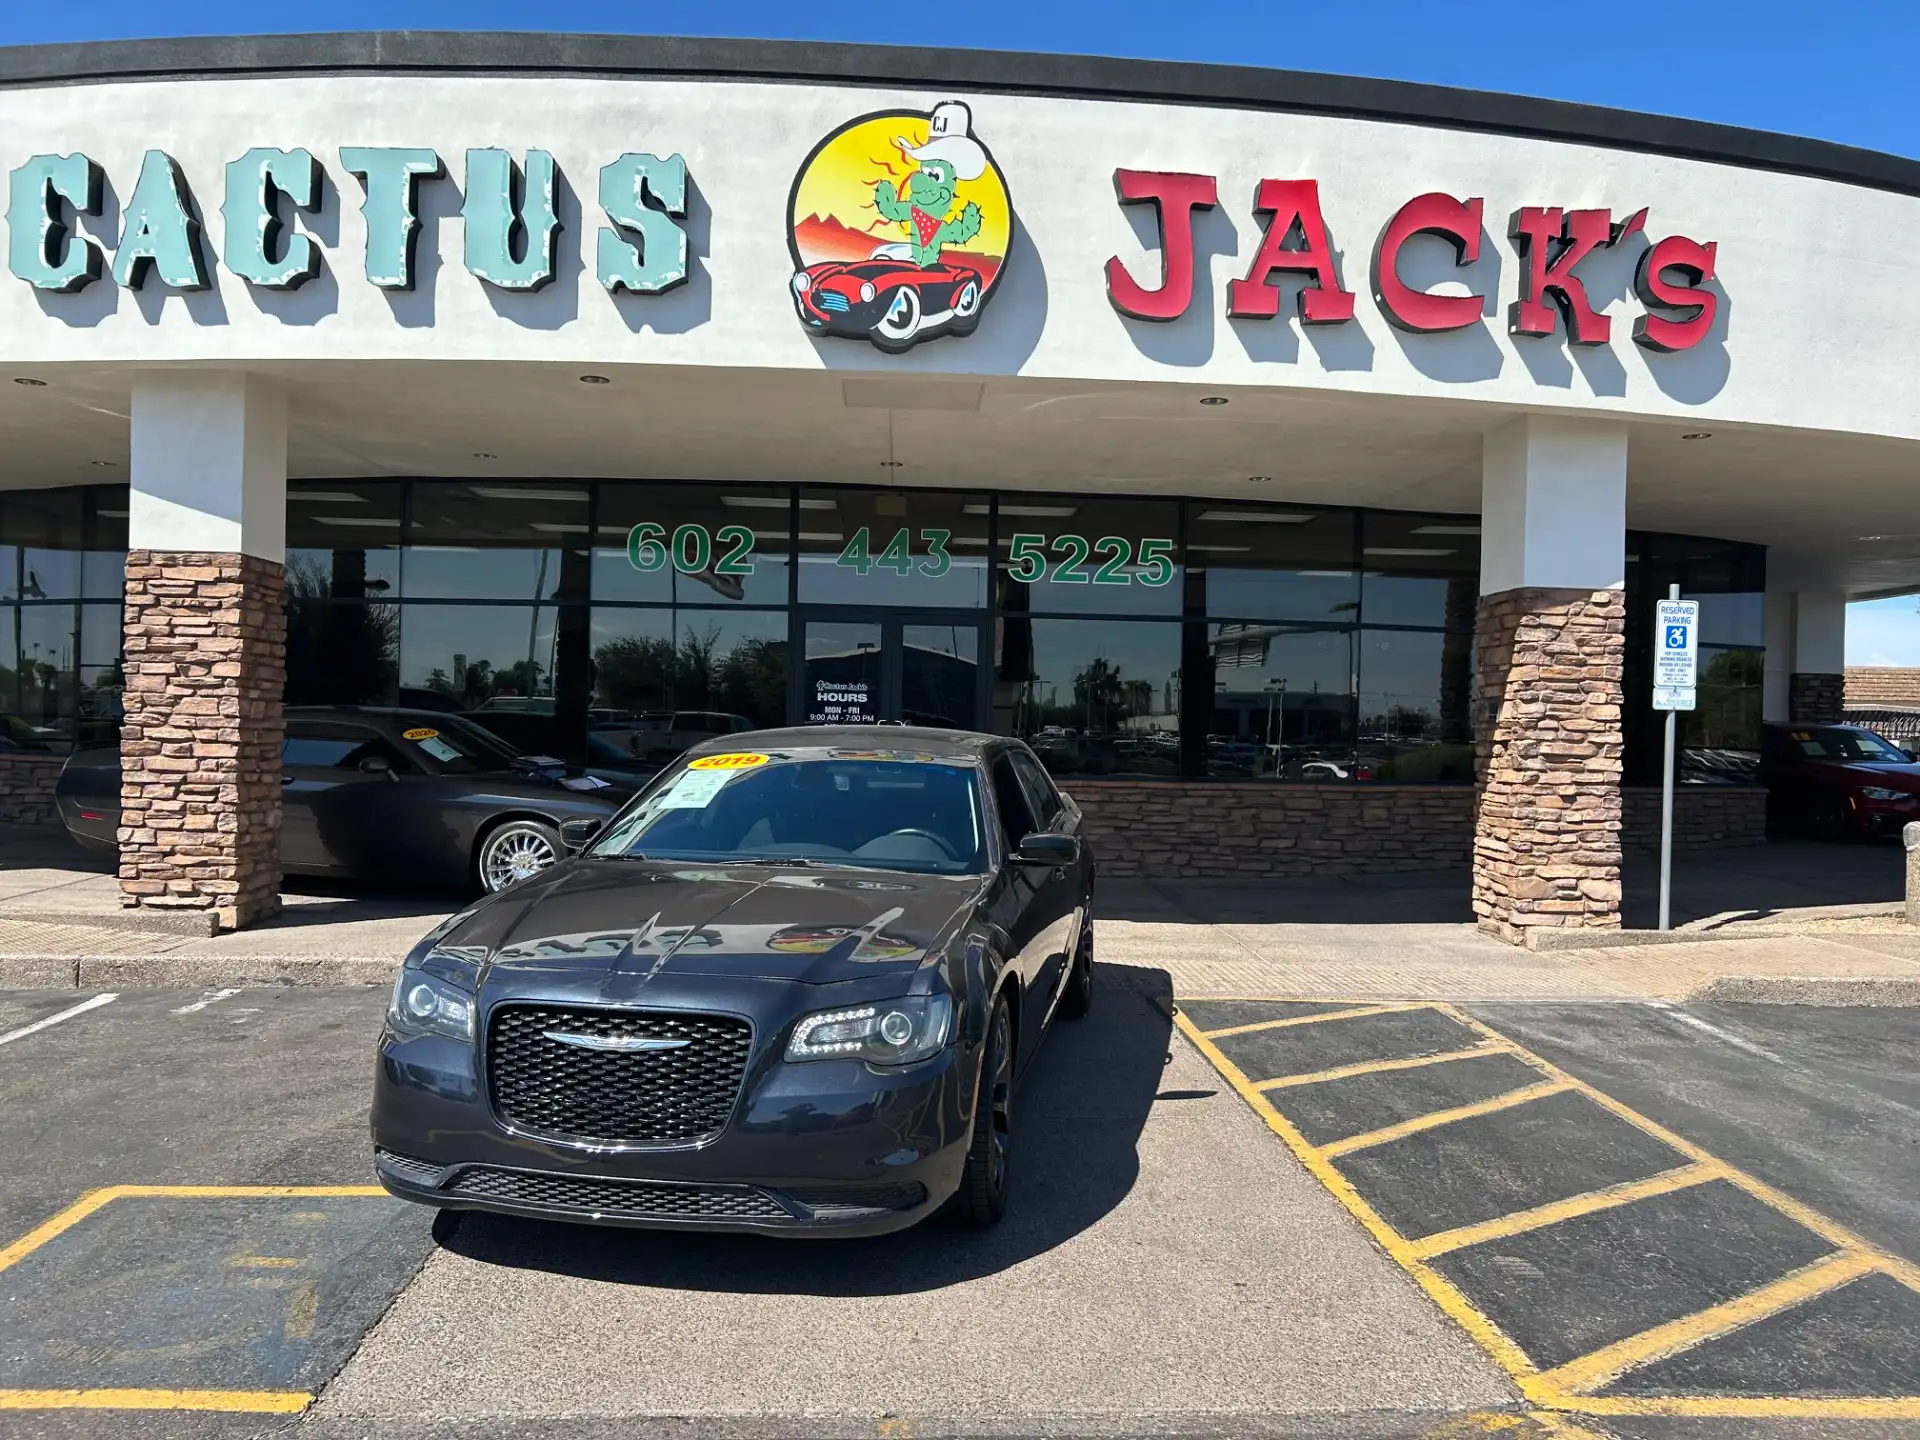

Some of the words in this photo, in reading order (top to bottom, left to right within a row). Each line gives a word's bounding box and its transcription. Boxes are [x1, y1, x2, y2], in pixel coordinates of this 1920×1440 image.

[931, 115, 949, 133] CJ
[4, 146, 690, 295] CACTUS
[626, 521, 756, 576] 602
[835, 526, 952, 577] 443
[1007, 533, 1174, 588] 5225
[1661, 606, 1695, 615] RESERVED
[1663, 616, 1692, 625] PARKING
[817, 692, 868, 703] HOURS
[824, 706, 842, 714] MON
[848, 706, 860, 714] FRI
[810, 713, 826, 721] 9:00
[845, 714, 861, 722] 7:00
[862, 714, 875, 722] PM
[696, 756, 760, 767] 2019
